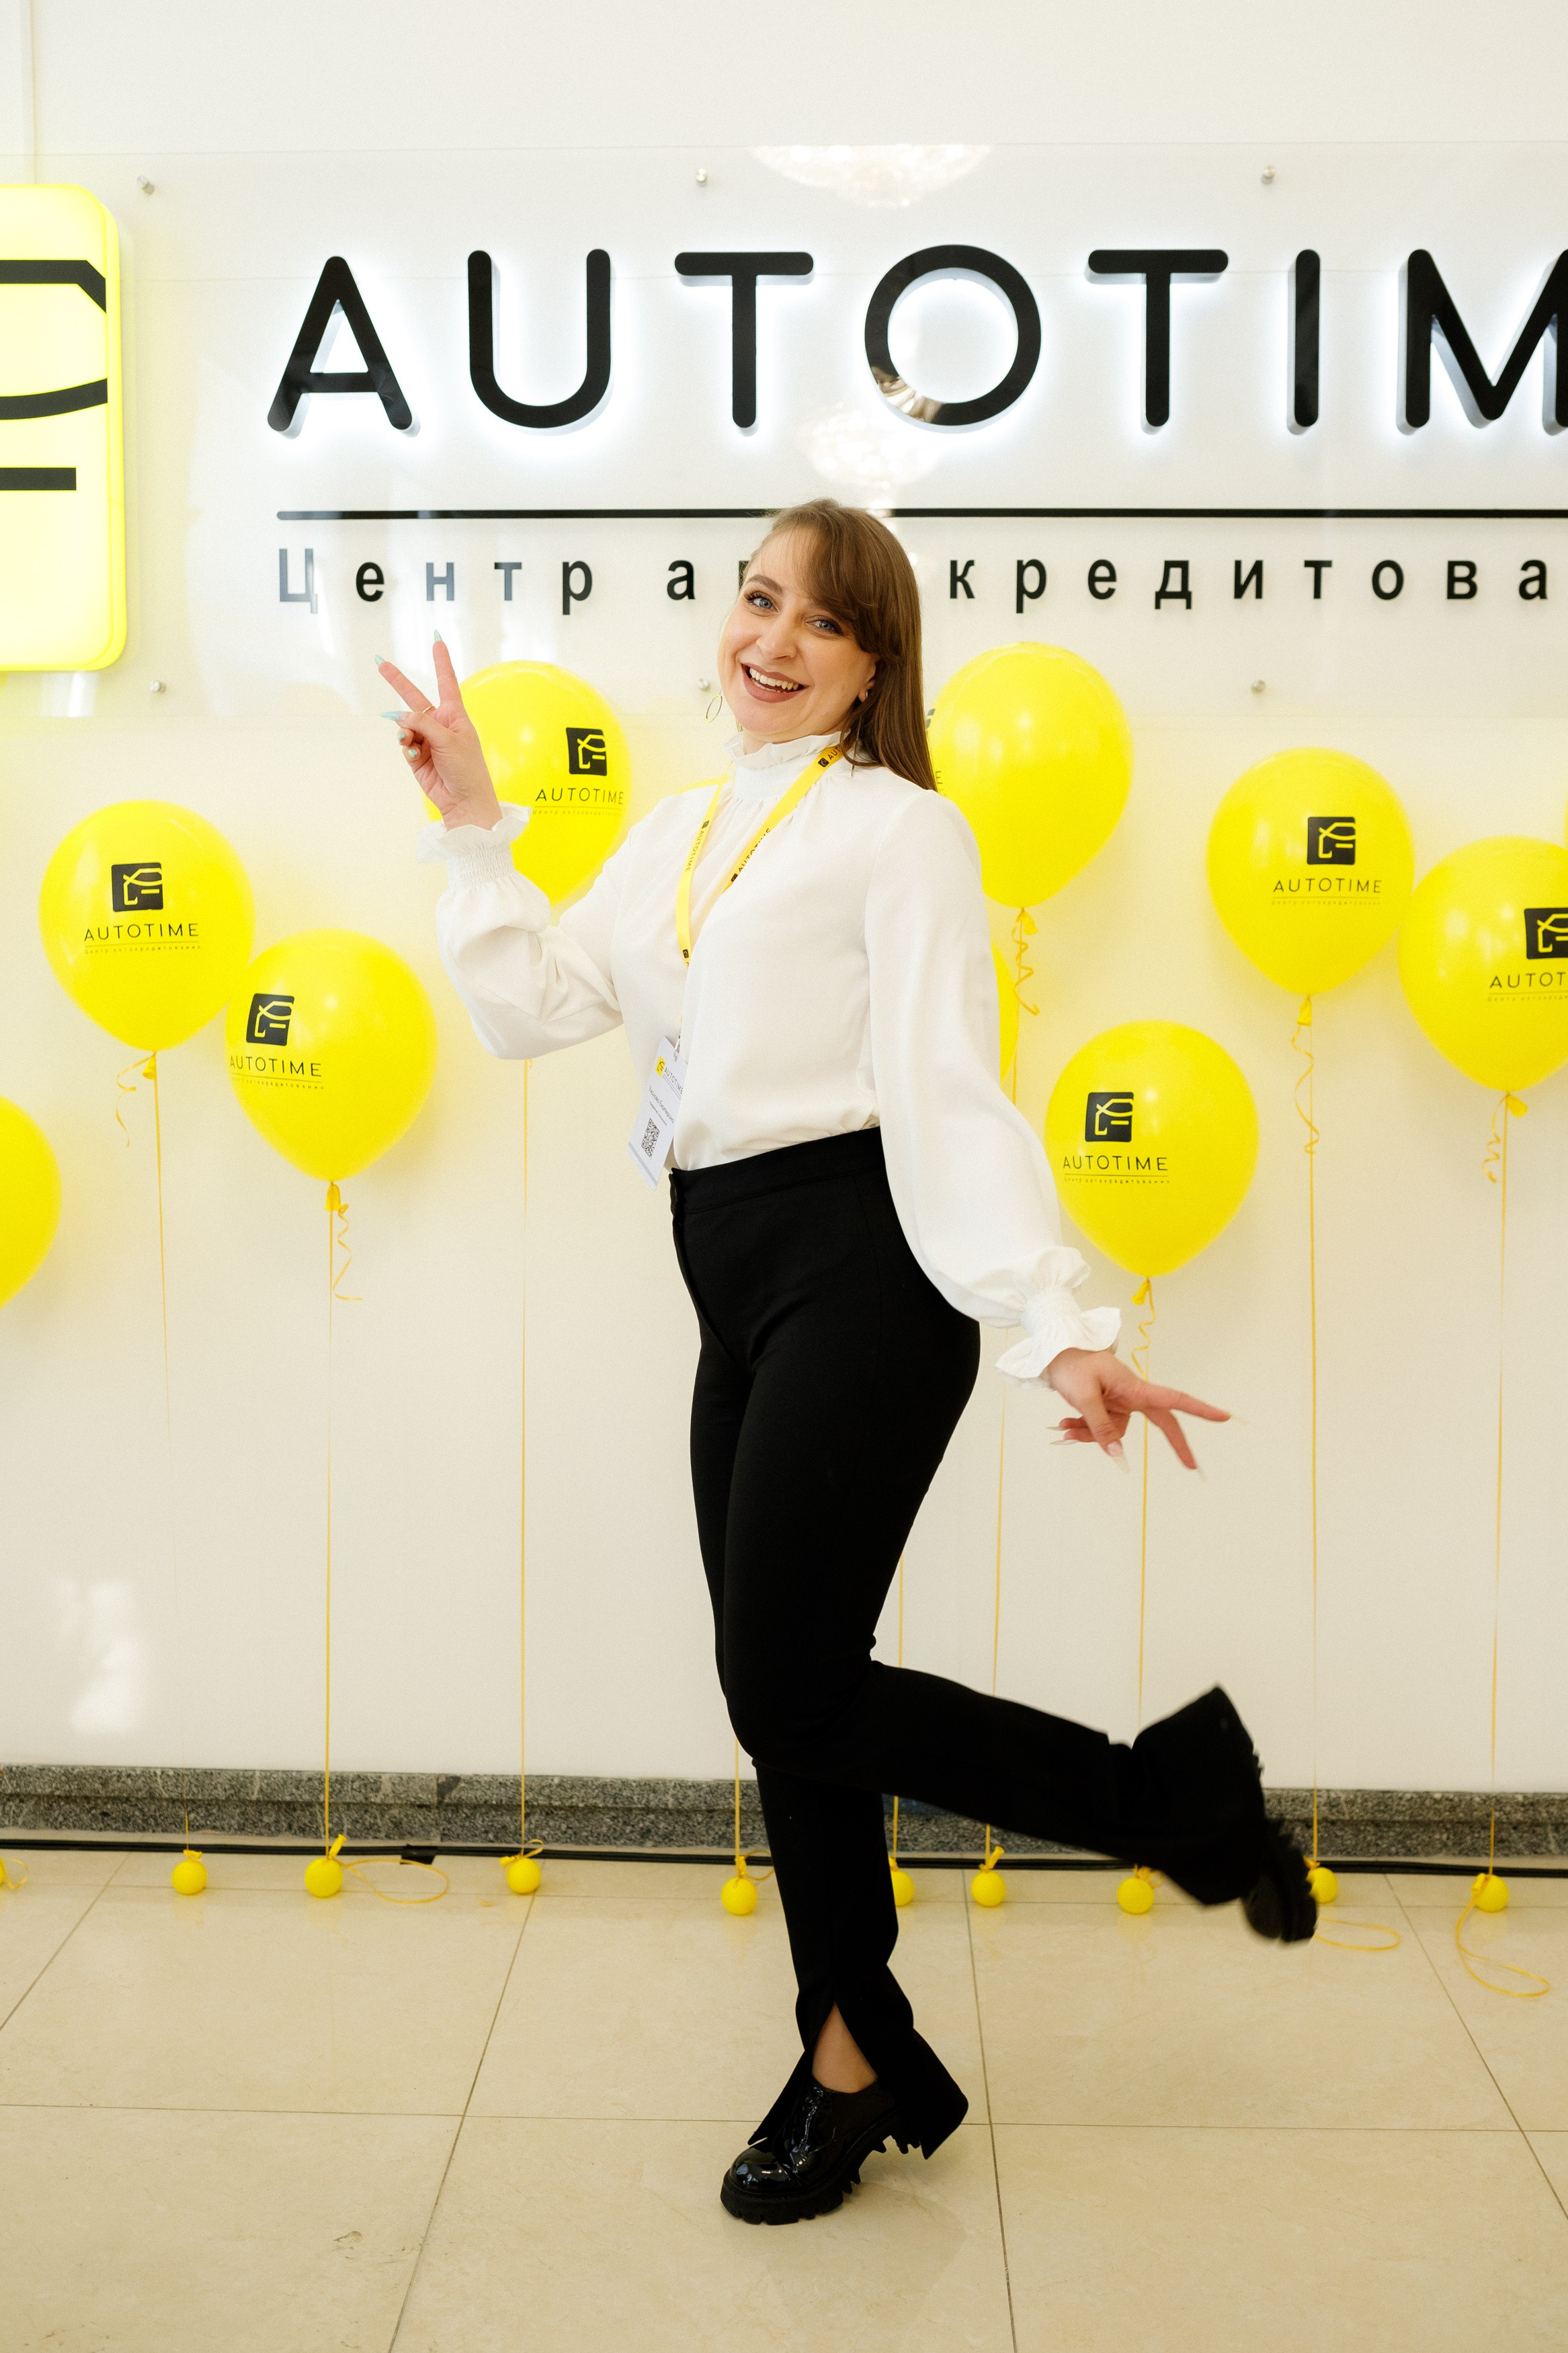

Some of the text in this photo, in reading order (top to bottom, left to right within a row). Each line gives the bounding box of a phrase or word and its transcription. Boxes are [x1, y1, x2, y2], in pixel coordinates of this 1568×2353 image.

[278, 548, 594, 615] Центр
[536, 787, 624, 805] AUTOTIME
[1273, 877, 1382, 893] AUTOTIME
[84, 923, 199, 941] AUTOTIME
[230, 1055, 322, 1077] AUTOTIME
[1063, 1155, 1168, 1171] AUTOTIME
